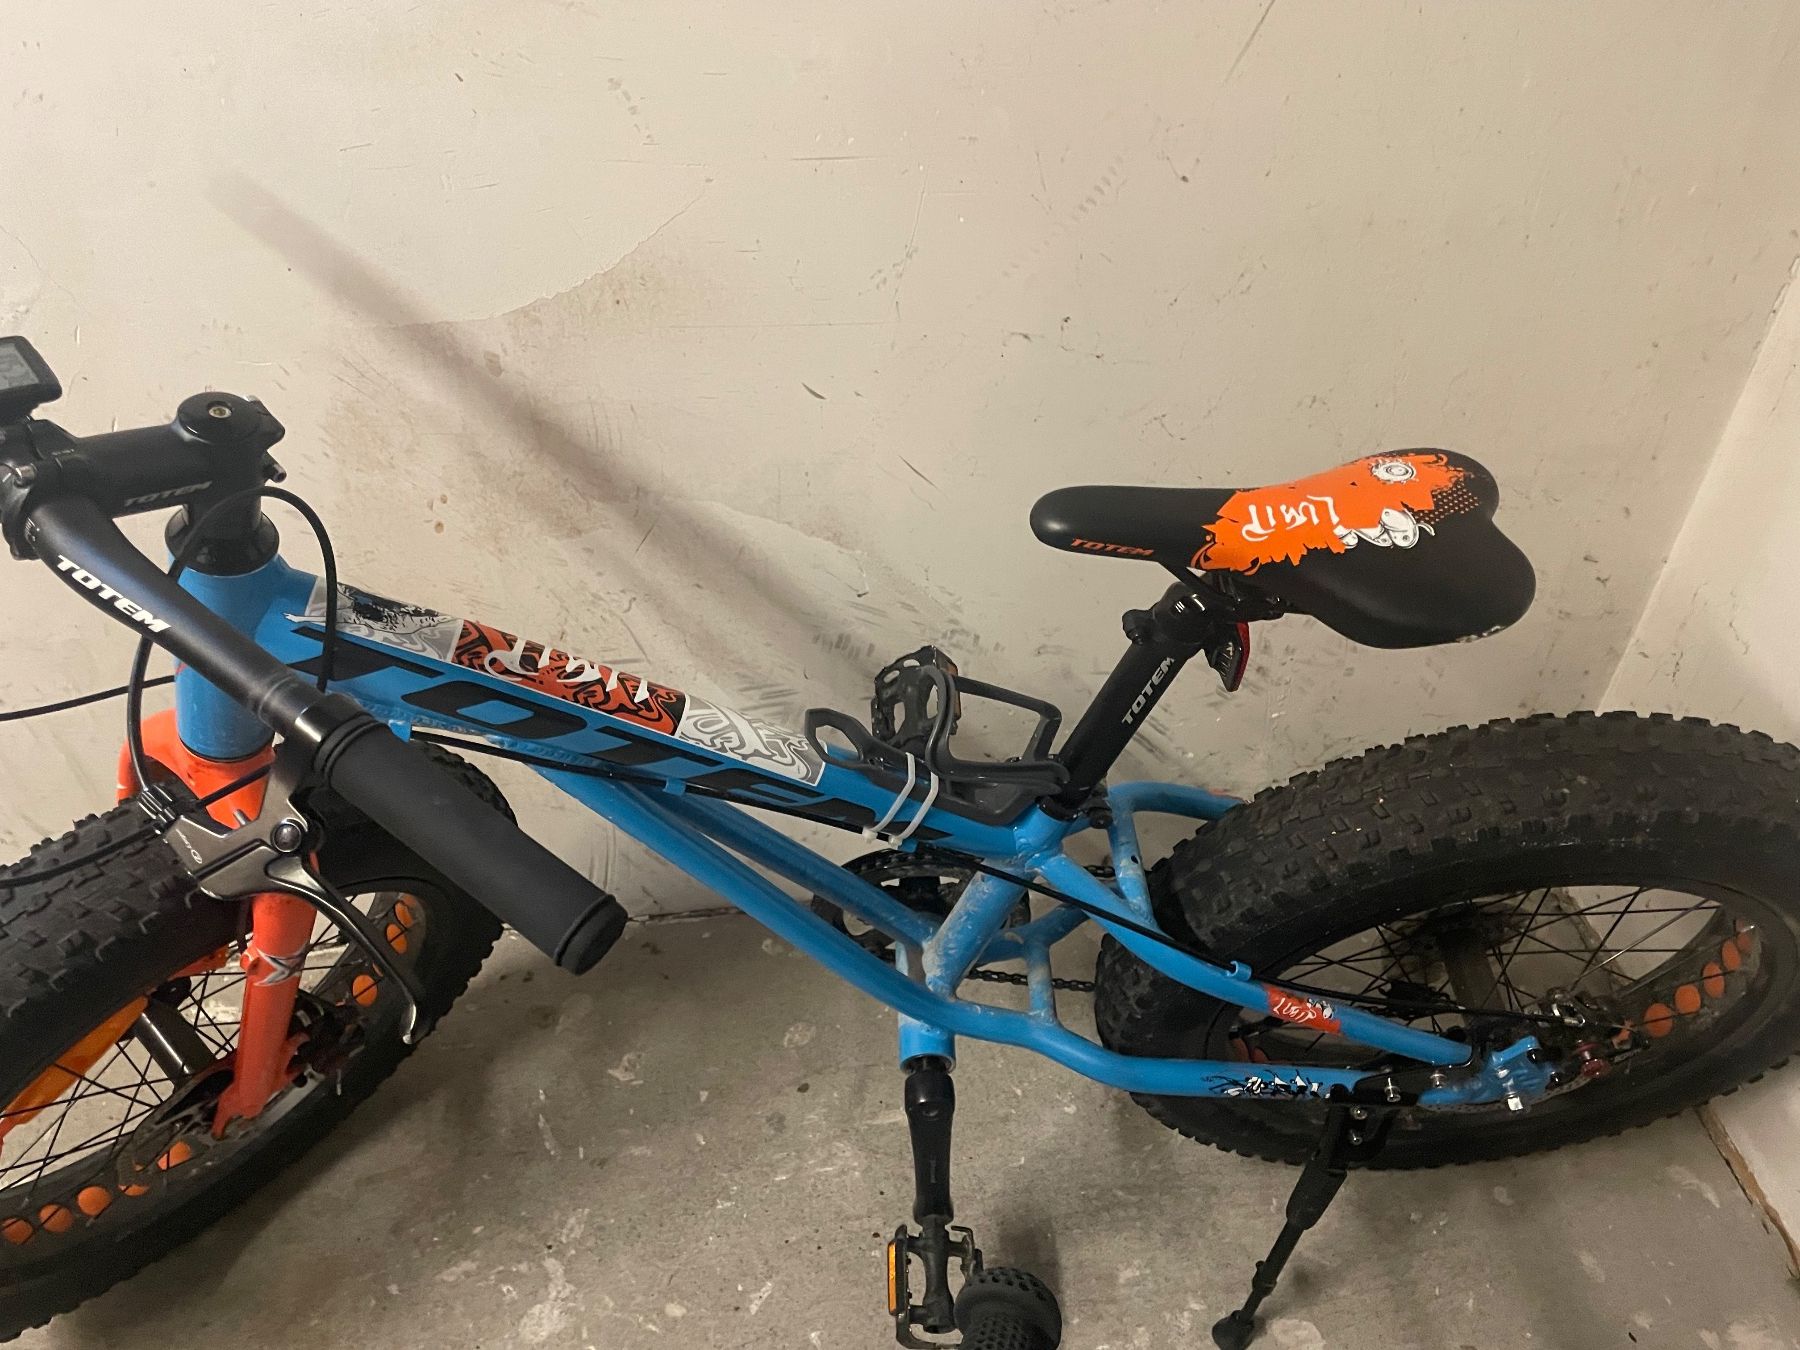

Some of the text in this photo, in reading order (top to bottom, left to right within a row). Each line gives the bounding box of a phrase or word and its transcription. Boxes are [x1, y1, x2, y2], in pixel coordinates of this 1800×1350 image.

[1070, 537, 1154, 557] TOTEM
[56, 554, 171, 634] TOTEM
[1121, 657, 1175, 725] TOTEM
